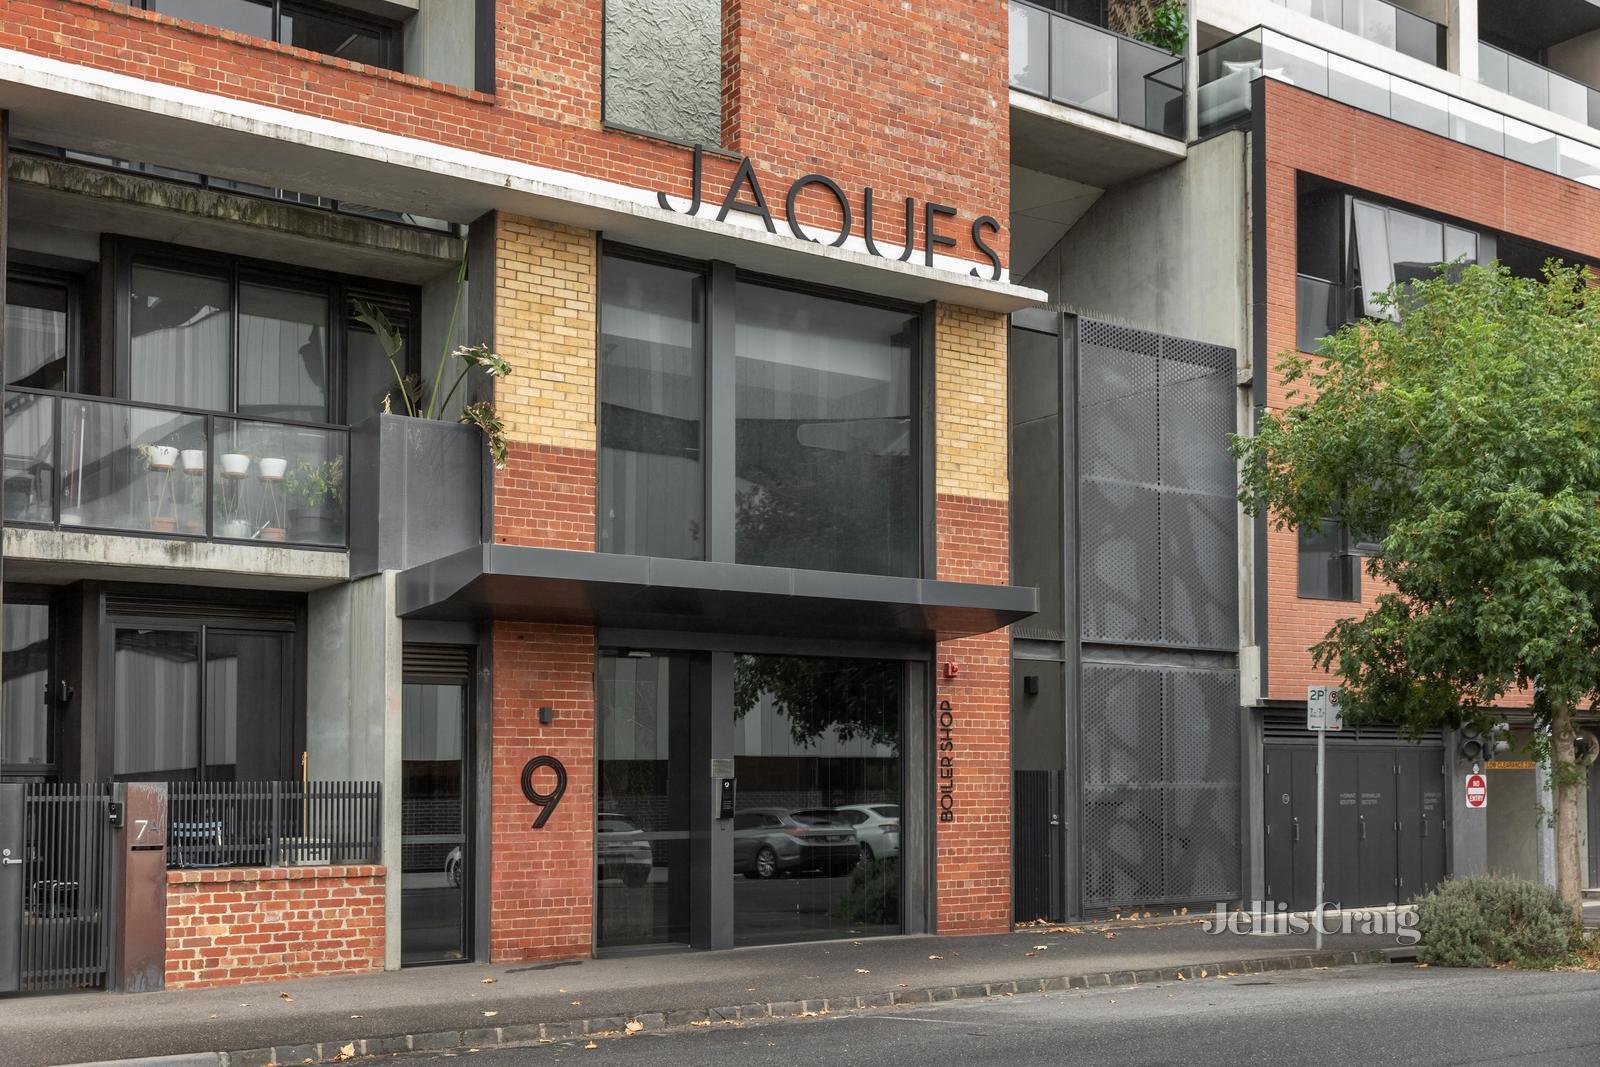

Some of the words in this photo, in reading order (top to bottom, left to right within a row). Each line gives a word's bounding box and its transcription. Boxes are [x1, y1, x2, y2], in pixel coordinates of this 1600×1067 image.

[1310, 690, 1325, 700] 2P
[940, 700, 953, 752] SHOP
[521, 755, 568, 829] 9
[940, 757, 953, 822] BOILER
